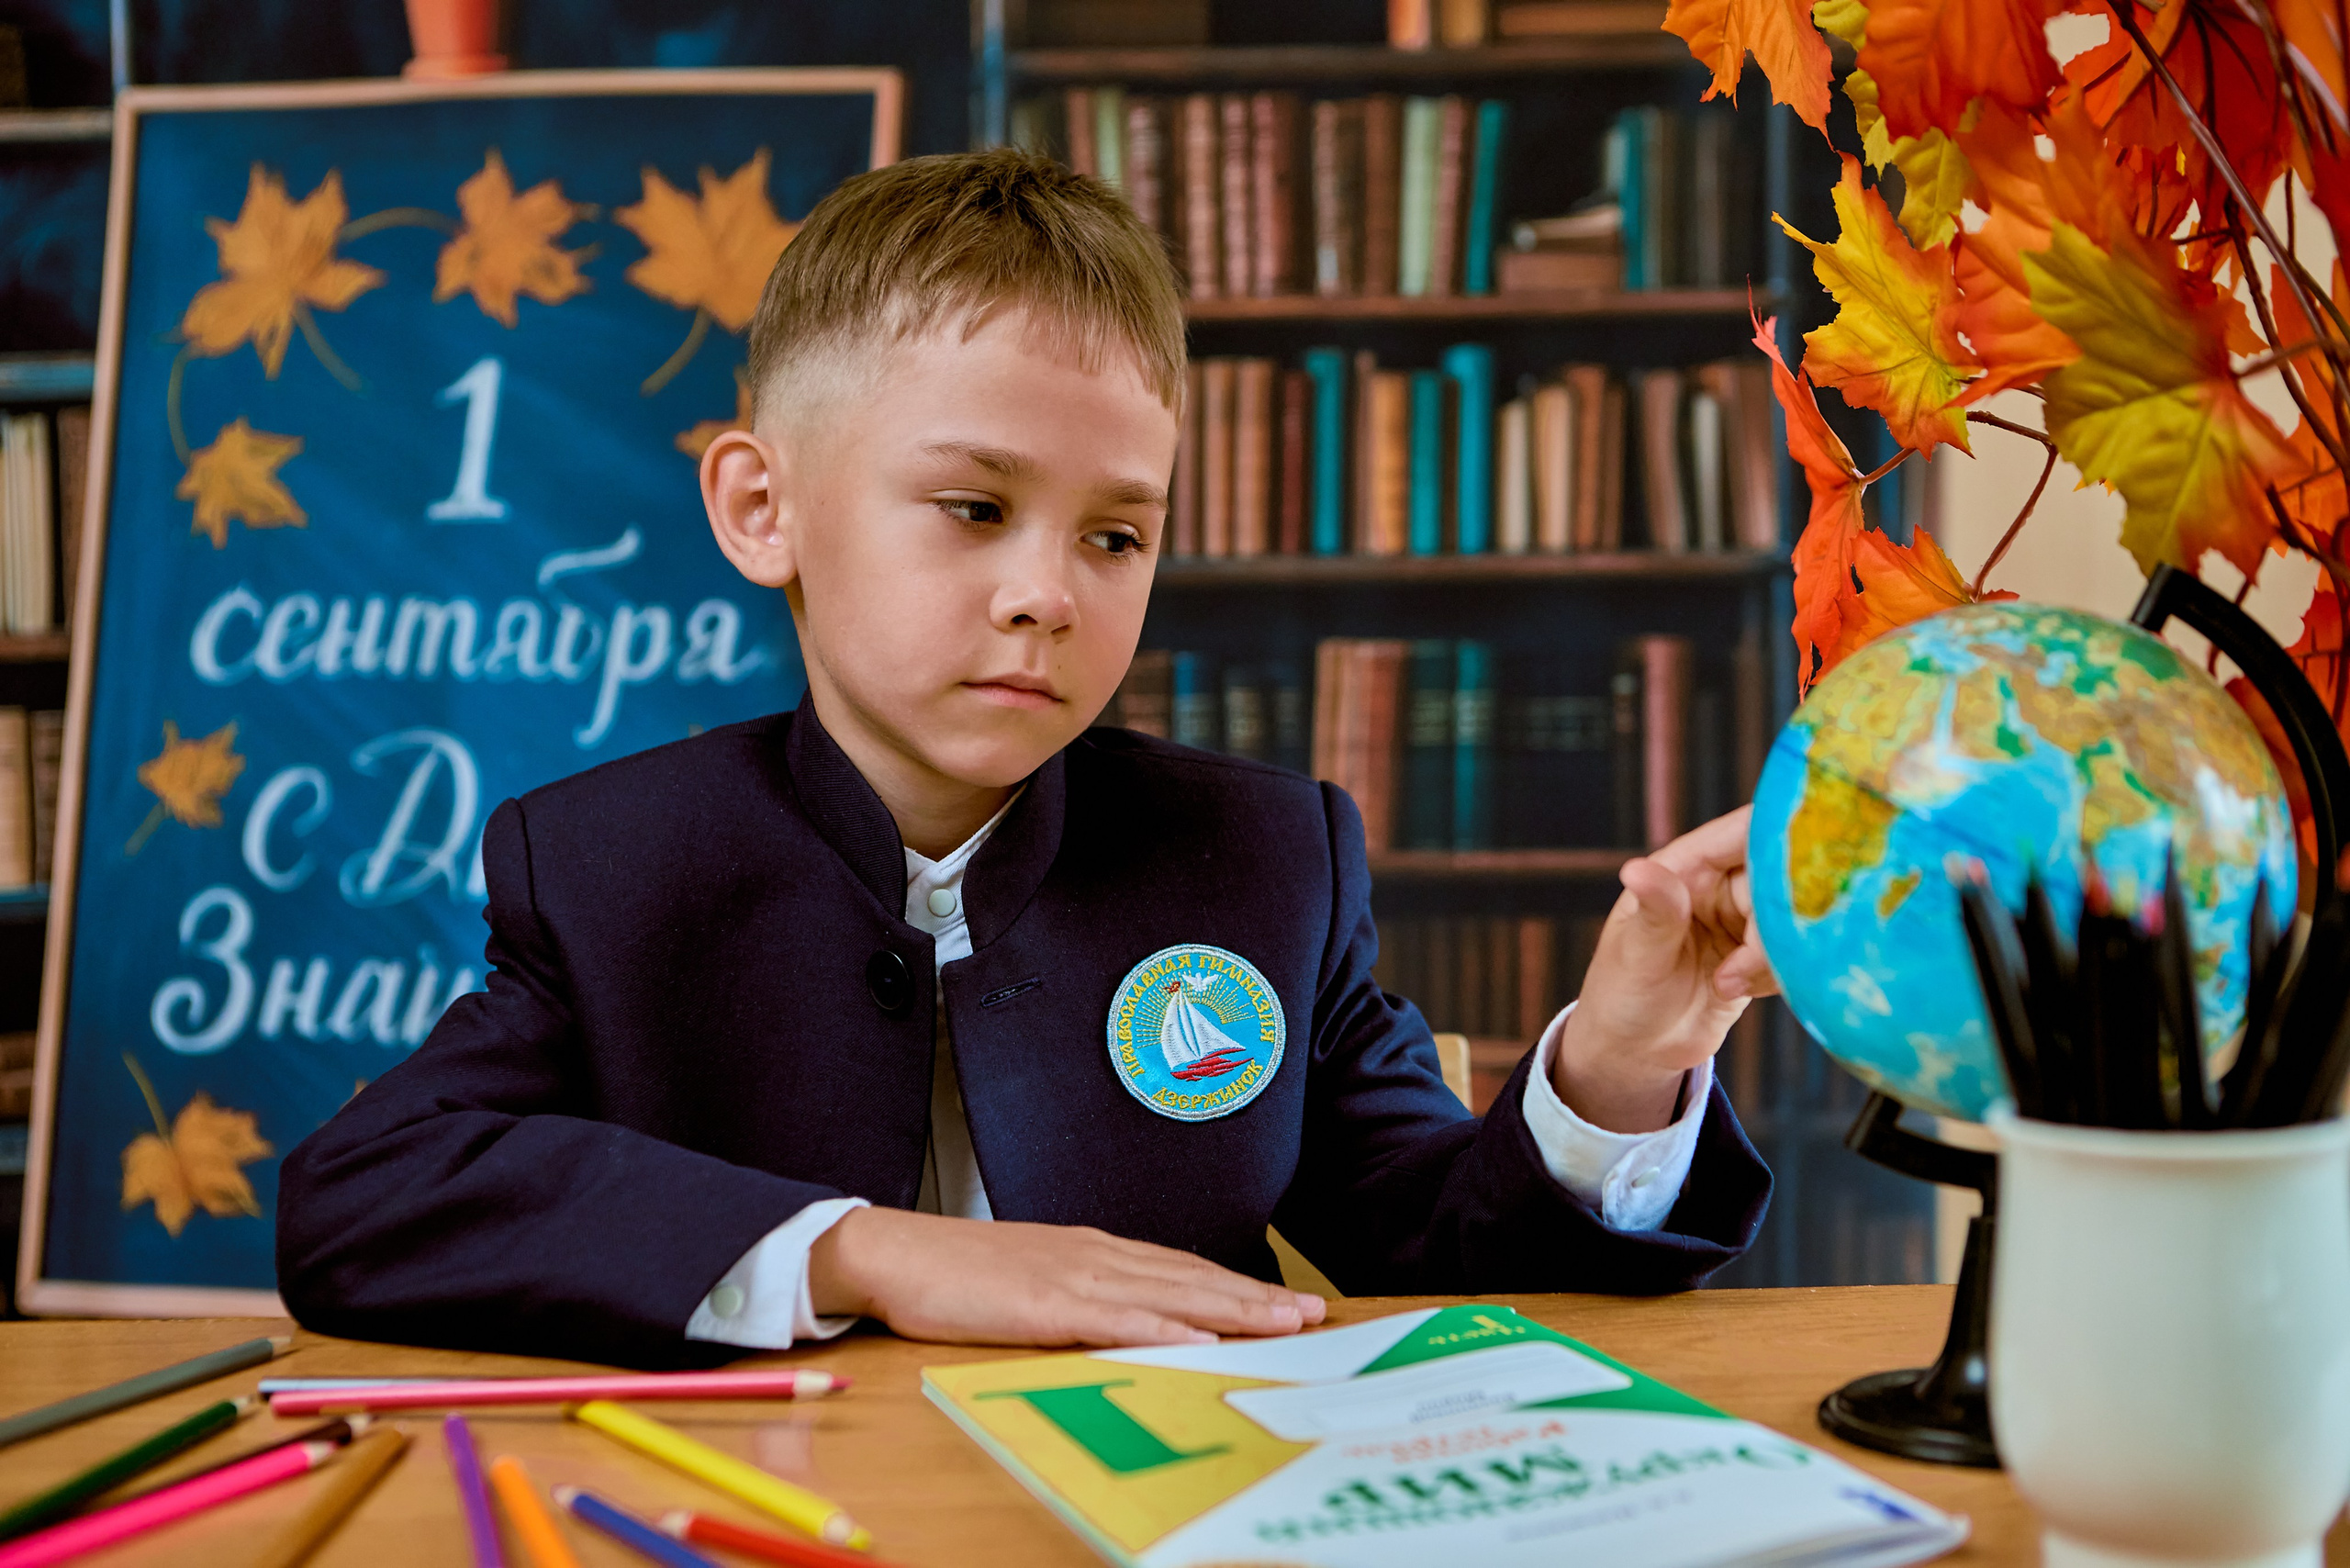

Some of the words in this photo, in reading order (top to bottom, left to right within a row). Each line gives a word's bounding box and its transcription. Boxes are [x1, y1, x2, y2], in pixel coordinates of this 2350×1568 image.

[428, 357, 509, 521] 1
[191, 525, 767, 745] сентября
[1198, 955, 1275, 1043] ГИМНАЗИЯ
